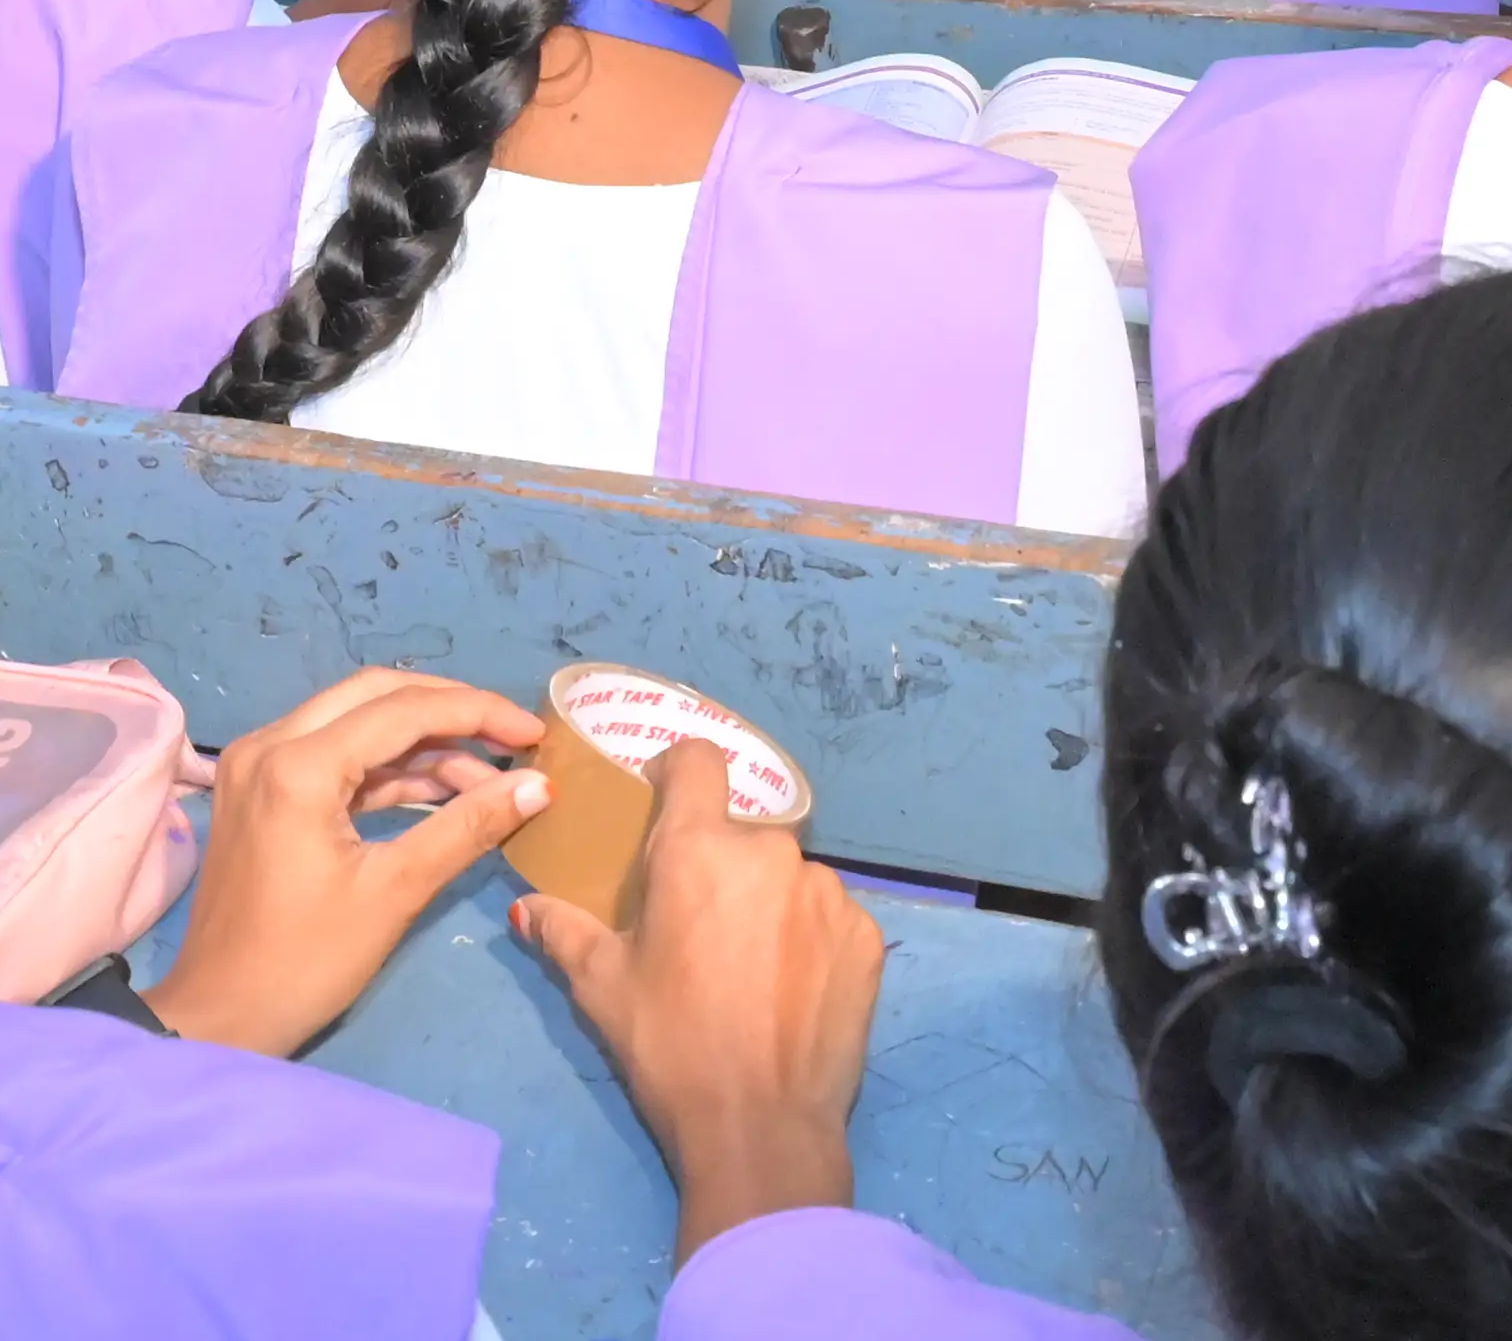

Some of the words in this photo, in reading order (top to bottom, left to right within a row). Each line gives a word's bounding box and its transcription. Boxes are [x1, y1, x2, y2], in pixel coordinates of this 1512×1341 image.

[576, 689, 614, 709] STAR
[621, 689, 665, 706] TAPE
[604, 722, 645, 737] FIVE
